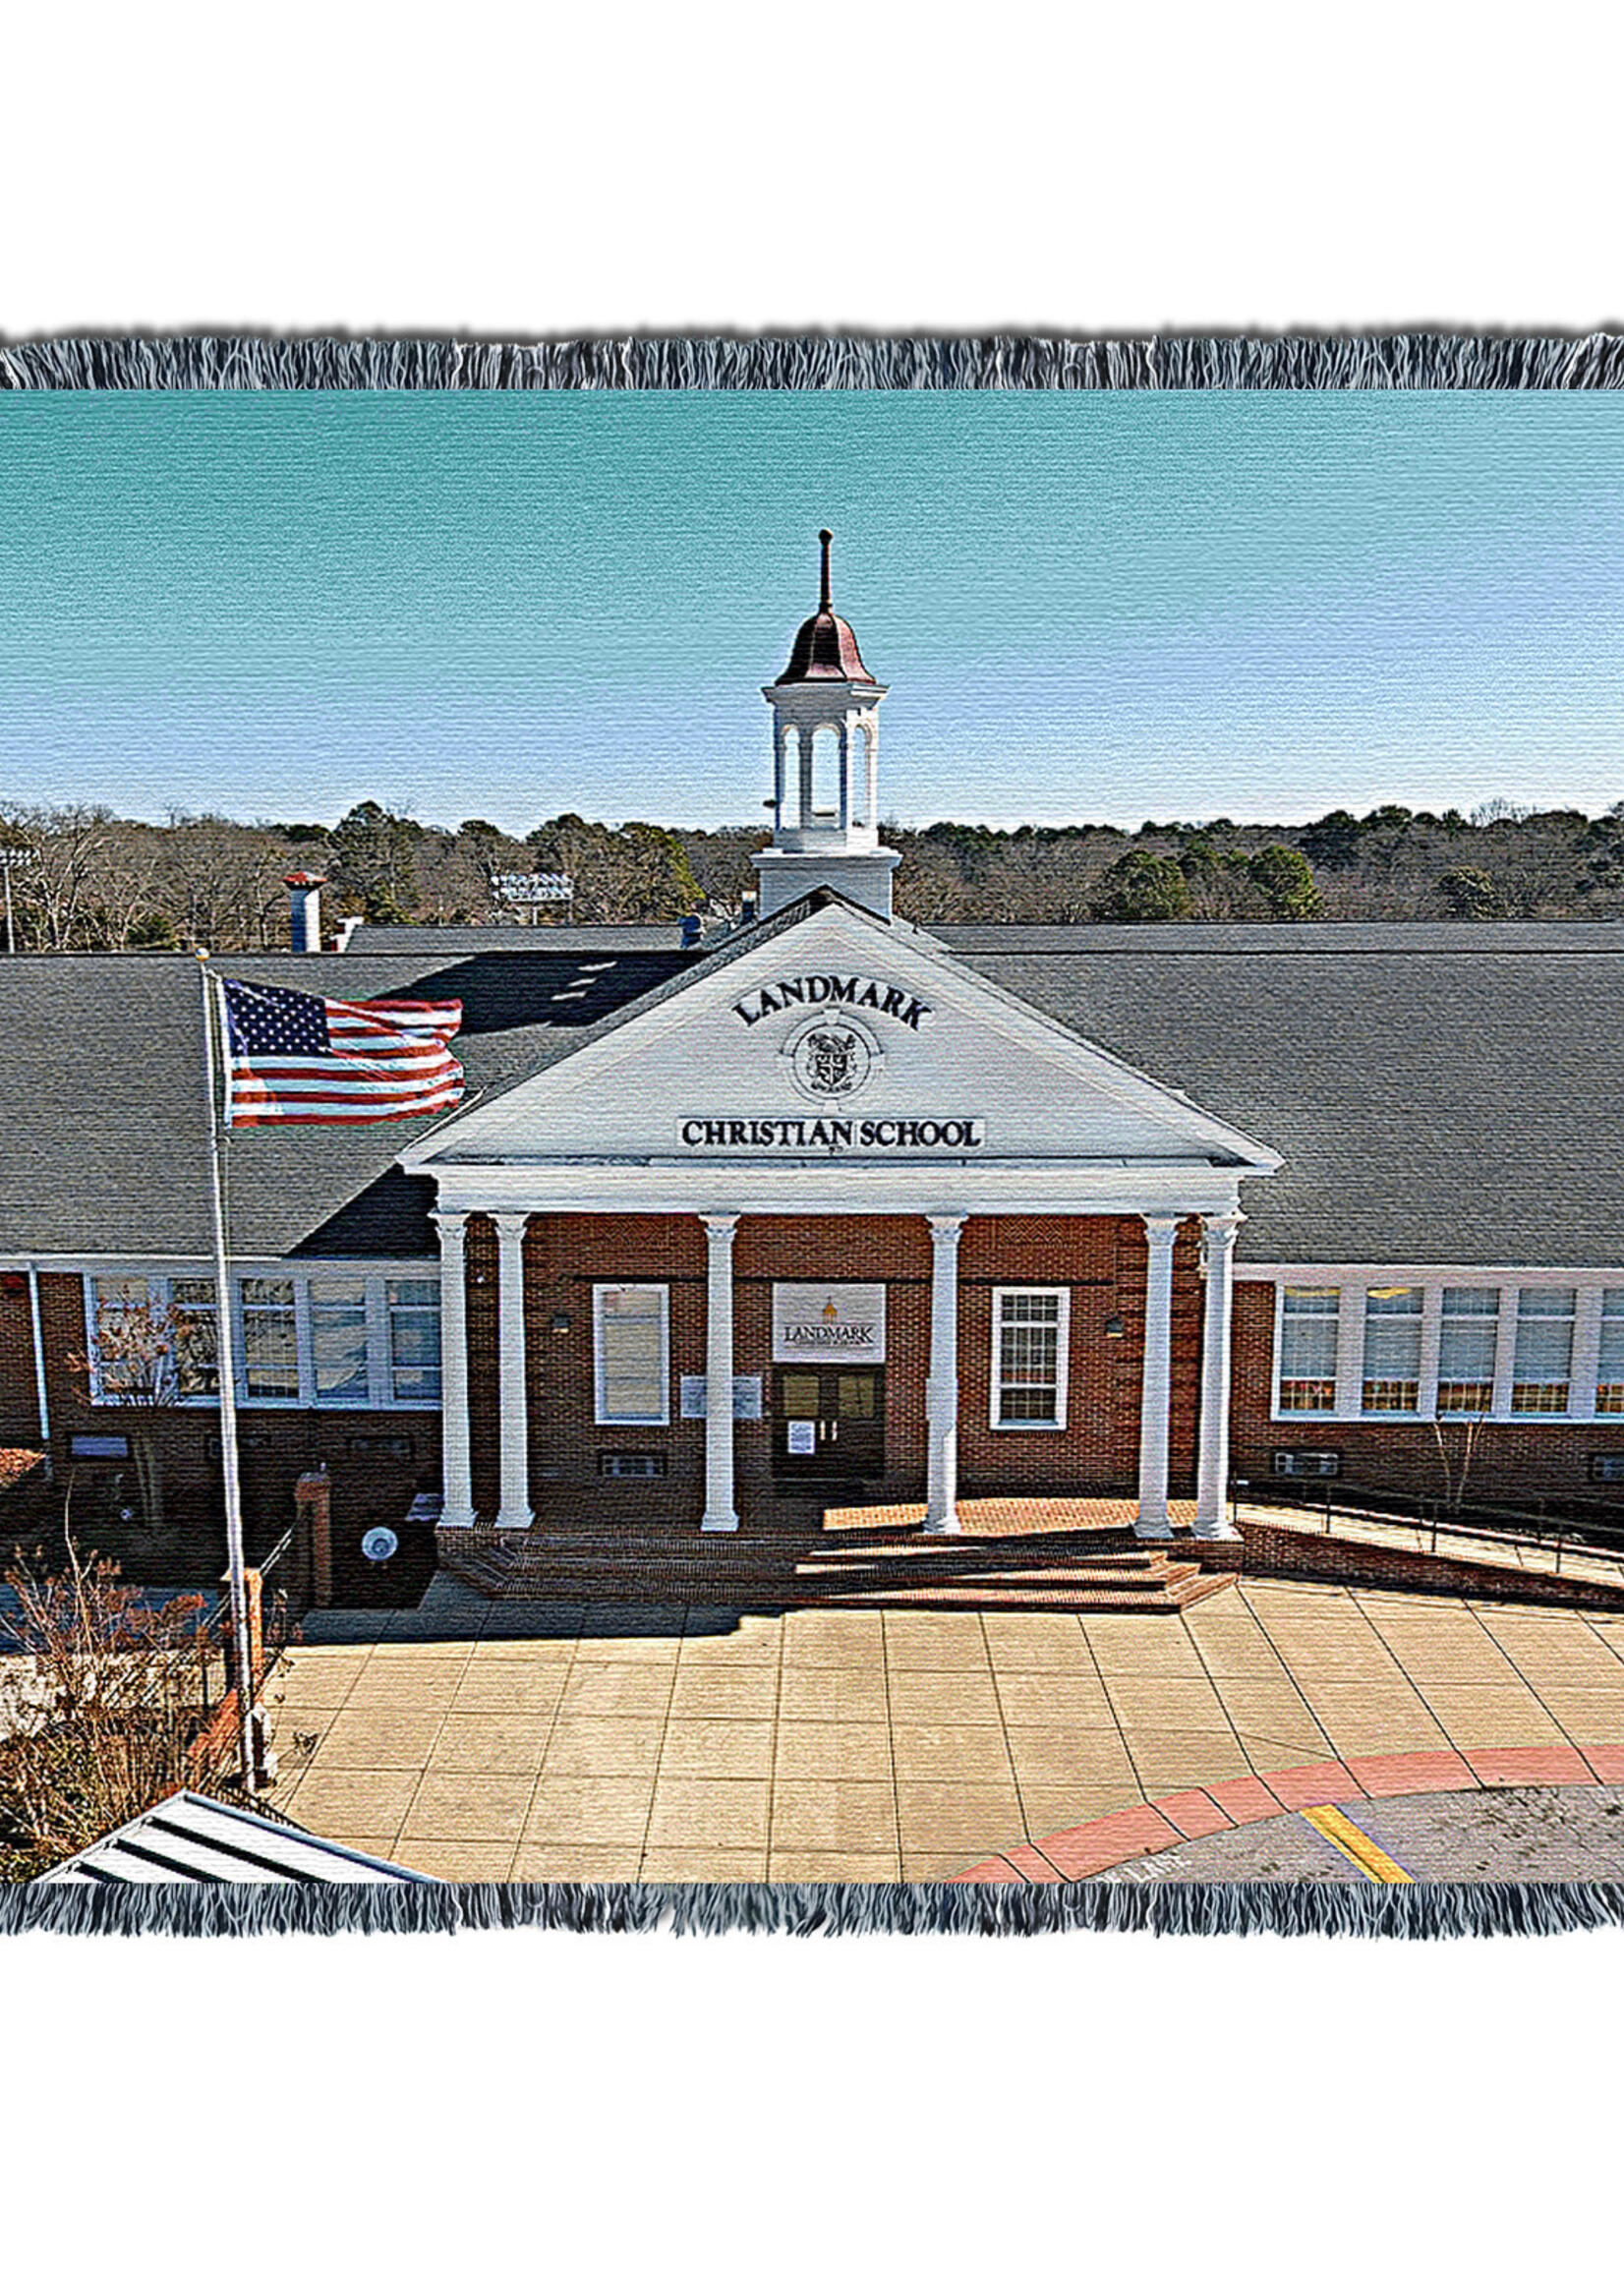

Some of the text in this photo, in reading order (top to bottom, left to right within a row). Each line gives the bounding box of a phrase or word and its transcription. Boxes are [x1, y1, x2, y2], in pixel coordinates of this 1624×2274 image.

[731, 974, 932, 1031] LANDMARK
[681, 1120, 982, 1147] CHRISTIAN SCHOOL
[783, 1325, 874, 1343] LANDMARK
